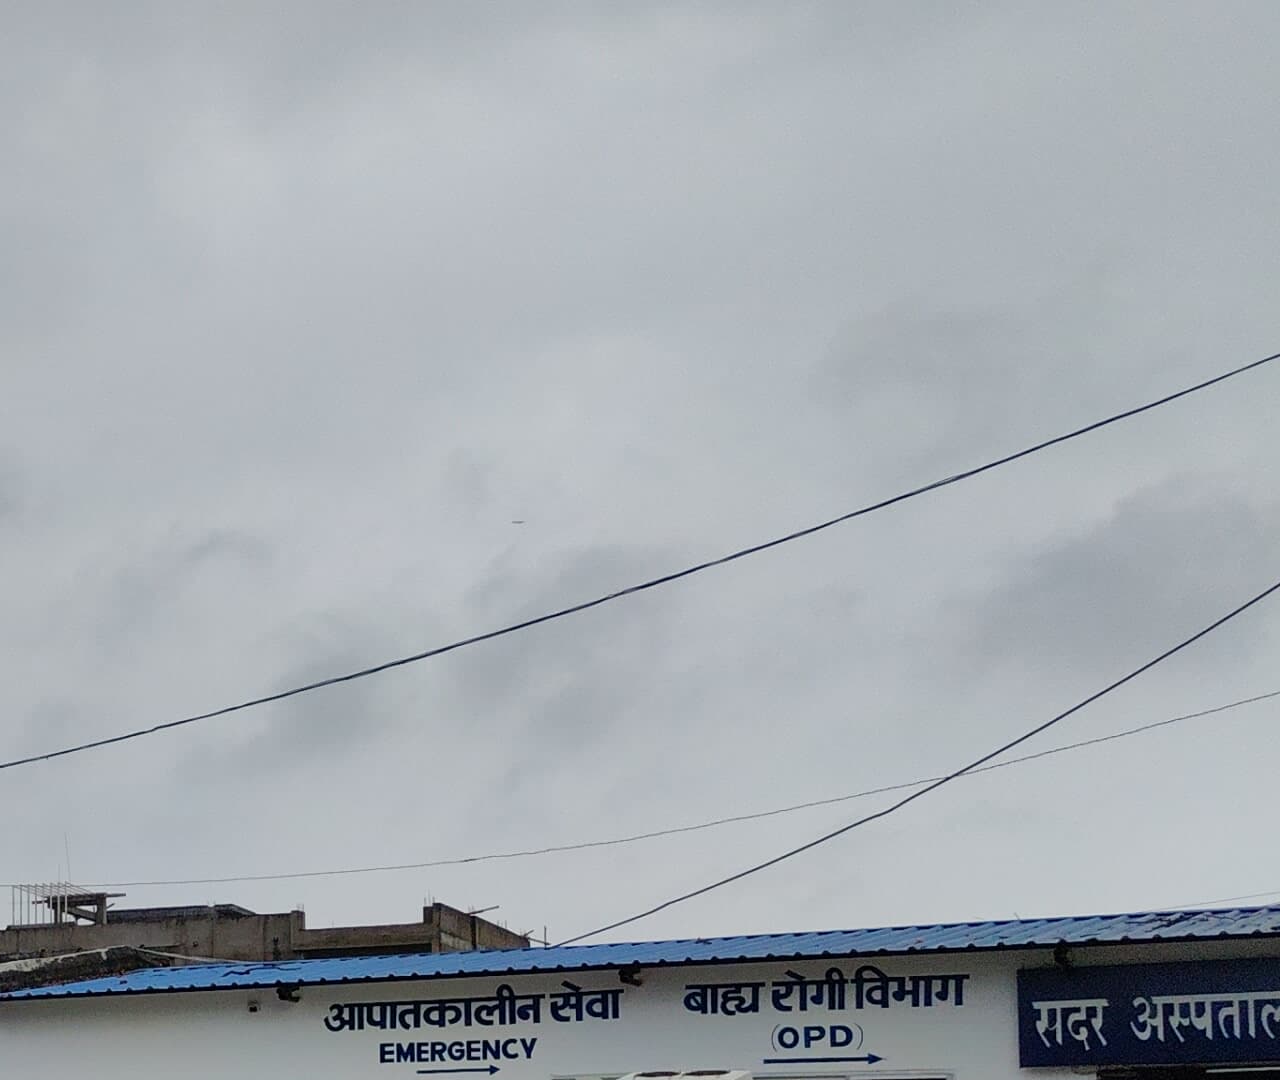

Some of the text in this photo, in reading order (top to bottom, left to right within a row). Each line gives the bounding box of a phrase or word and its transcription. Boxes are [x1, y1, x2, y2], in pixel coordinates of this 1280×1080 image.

[323, 980, 625, 1032] आपातकालीन सेवा
[683, 965, 971, 1016] बाह्य रोगी विभाग
[771, 1022, 864, 1052] (OPD)
[1032, 998, 1110, 1051] सदर
[379, 1037, 538, 1064] EMERGENCY
